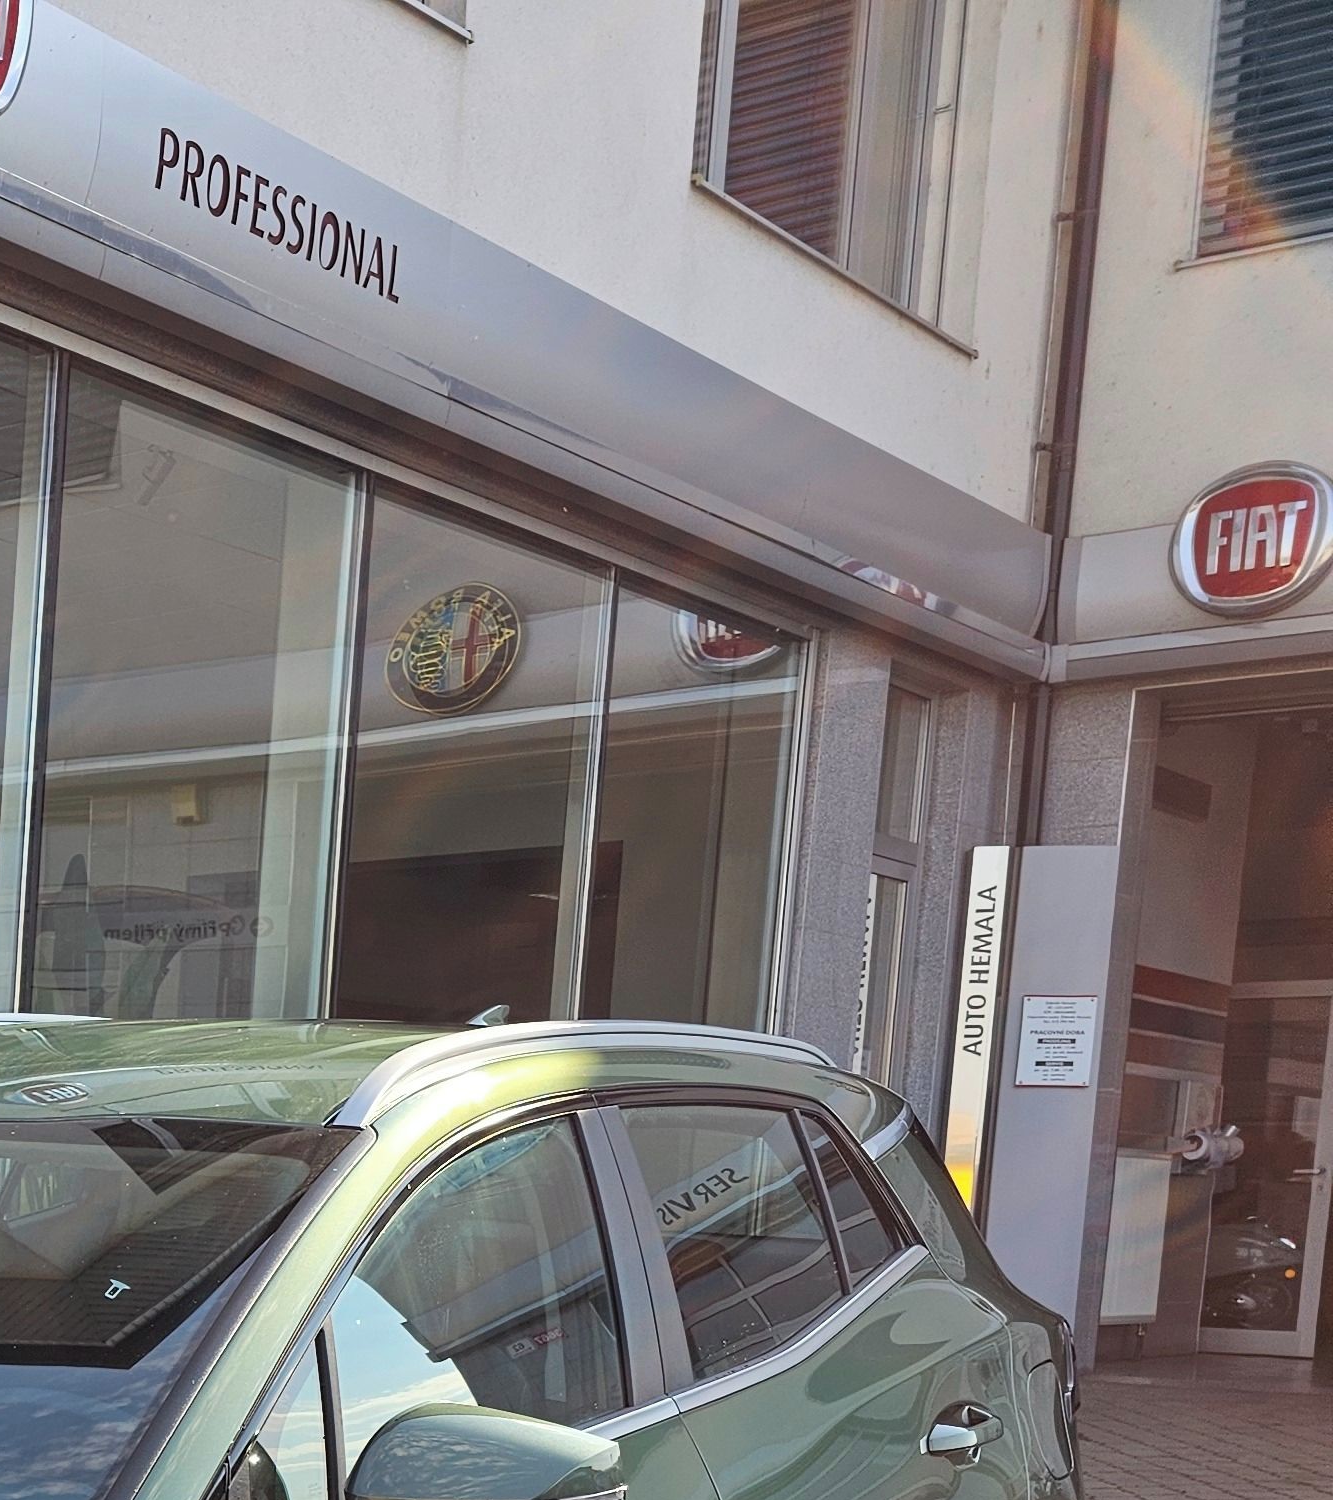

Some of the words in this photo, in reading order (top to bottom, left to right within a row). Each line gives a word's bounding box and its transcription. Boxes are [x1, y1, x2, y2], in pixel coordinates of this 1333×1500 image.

[154, 127, 401, 305] PROFESSIONAL
[1204, 499, 1308, 576] FIAT
[966, 884, 998, 984] HEMALA
[960, 993, 987, 1057] AUTO
